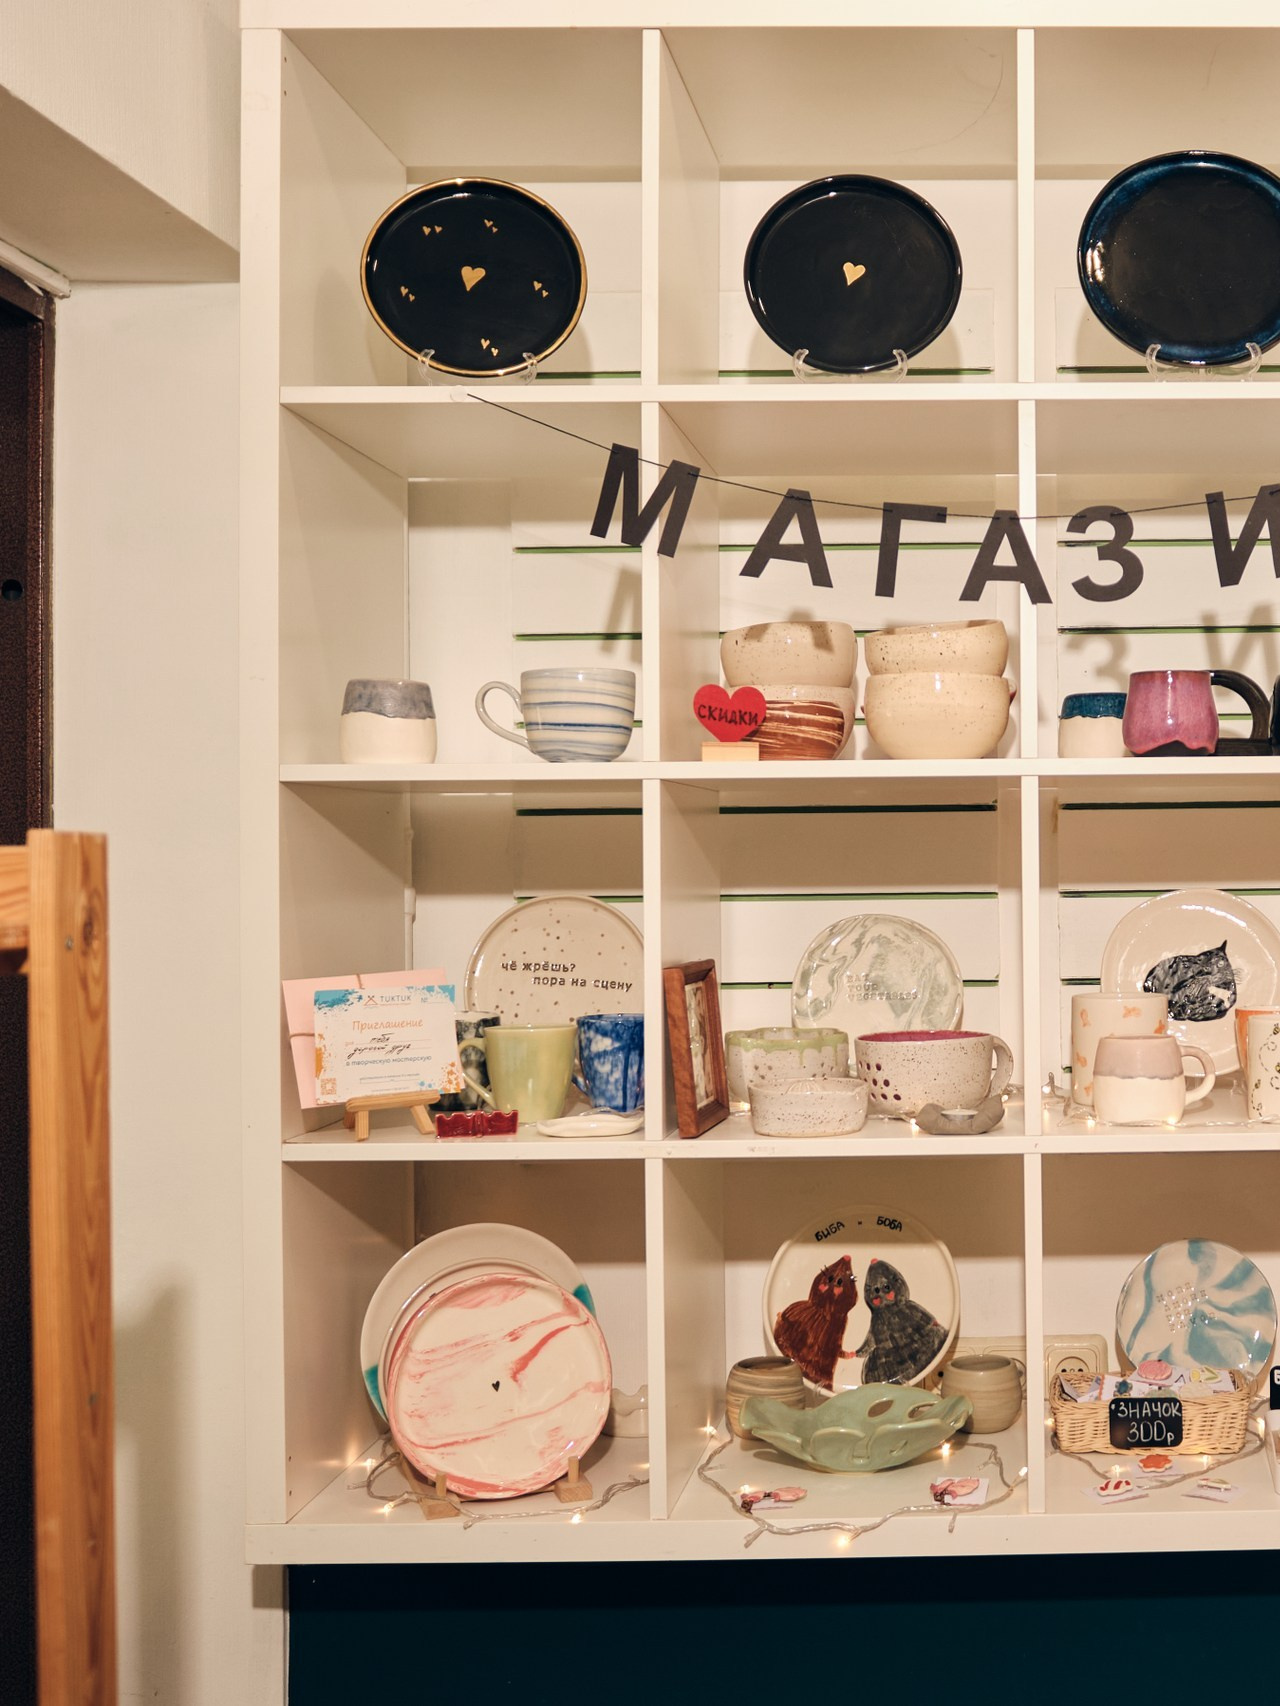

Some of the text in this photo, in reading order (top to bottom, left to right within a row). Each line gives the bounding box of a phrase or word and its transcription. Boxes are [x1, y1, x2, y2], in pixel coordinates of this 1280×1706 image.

[697, 704, 758, 726] СКИДКИ
[502, 961, 576, 973] чё жрёшь?
[533, 976, 632, 992] пора на сцену
[352, 1019, 424, 1033] Приглашение
[815, 1216, 903, 1241] БИБА БОБА
[1117, 1402, 1181, 1419] ЗНАЧОК
